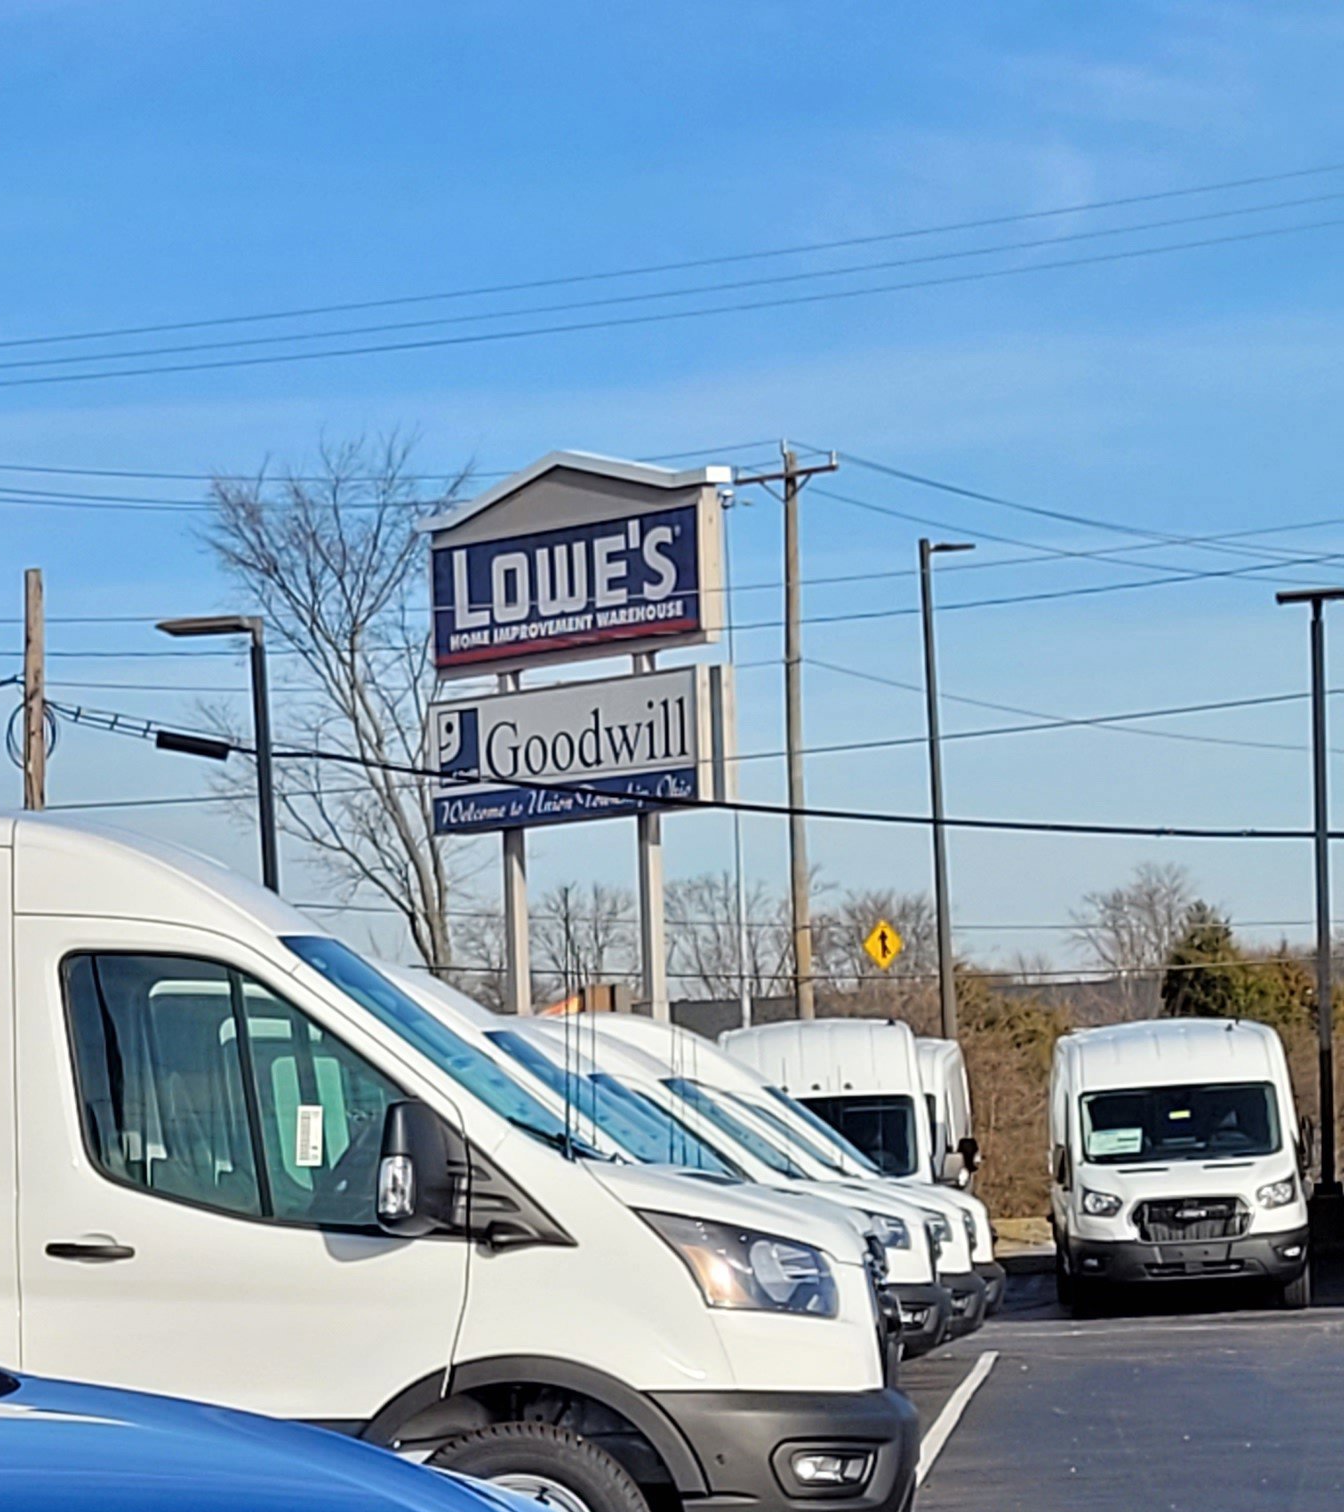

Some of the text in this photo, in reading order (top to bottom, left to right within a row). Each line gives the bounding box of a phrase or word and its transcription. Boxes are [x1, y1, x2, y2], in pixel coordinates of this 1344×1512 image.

[453, 520, 677, 630] LOWE'S
[449, 600, 683, 652] HOME IMPROVEMENT WAREHOUSE
[486, 696, 689, 779] Goodwill
[442, 800, 506, 824] Welcome
[510, 801, 524, 816] to
[528, 789, 574, 815] Union
